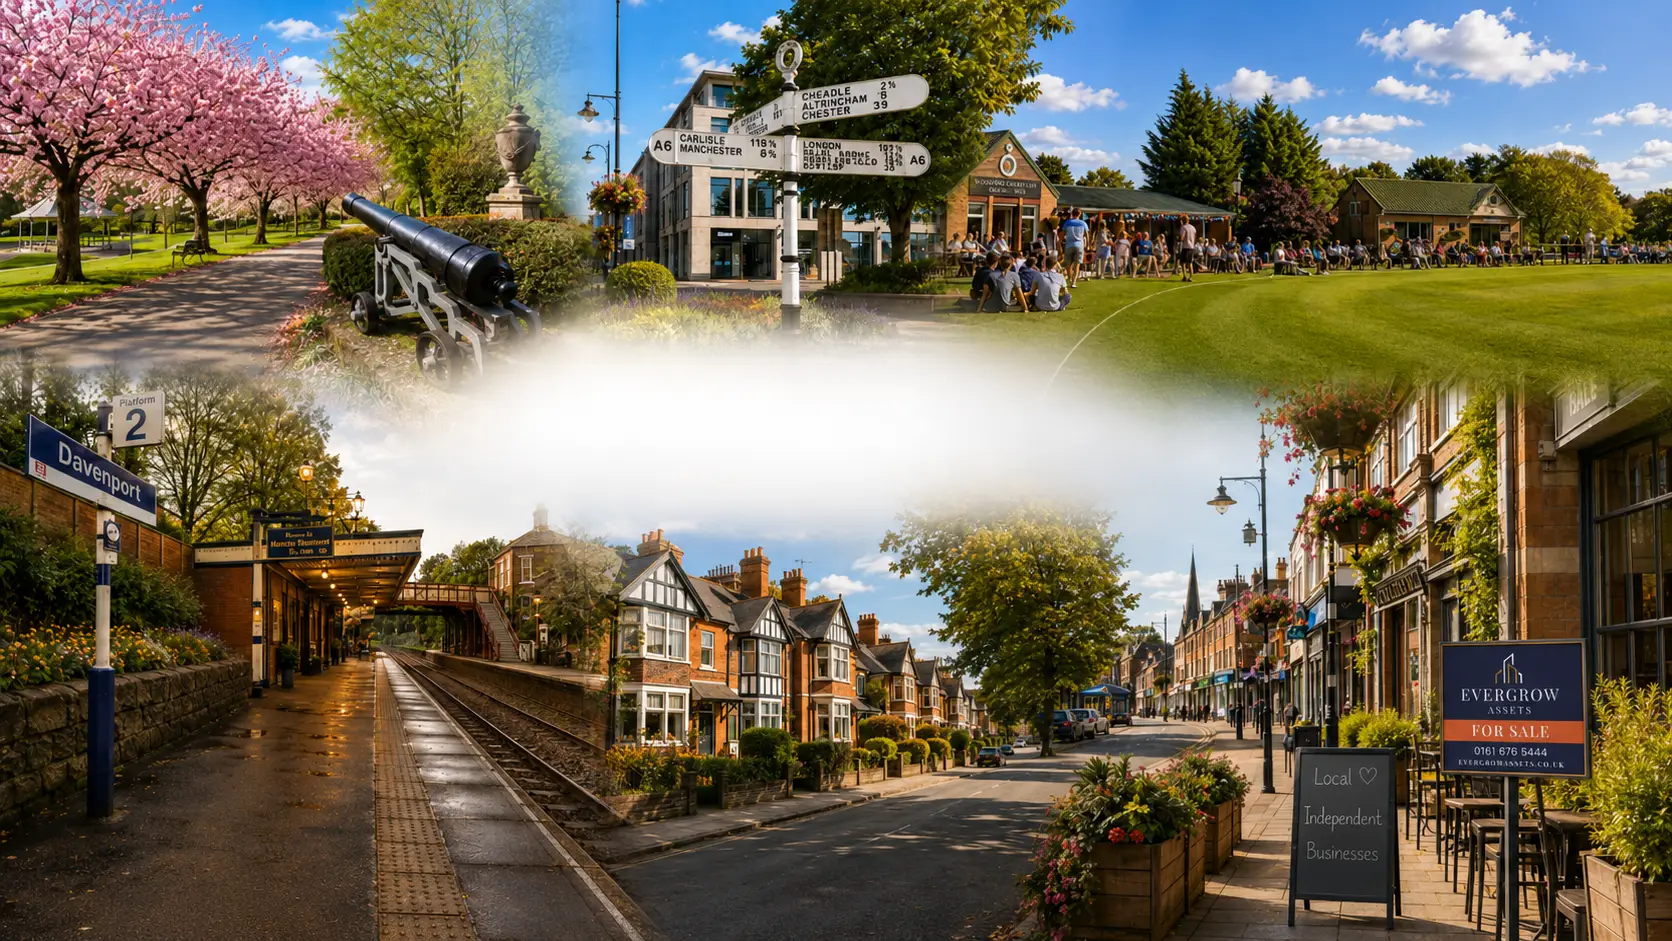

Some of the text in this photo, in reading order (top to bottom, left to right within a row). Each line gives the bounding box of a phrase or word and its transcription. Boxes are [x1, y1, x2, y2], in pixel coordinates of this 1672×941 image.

[802, 86, 851, 101] CHEADLE
[802, 94, 868, 111] ALTRINCHAM
[802, 100, 888, 120] CHESTER 39
[653, 140, 672, 152] A6
[680, 134, 726, 145] CARLISLE
[680, 144, 742, 156] MANCHESTER
[910, 156, 926, 165] A6
[119, 394, 156, 408] Platform
[125, 408, 147, 441] 2
[58, 441, 141, 502] Davenport
[1461, 688, 1560, 702] EVERGROW
[1487, 706, 1532, 715] ASSETS
[1471, 724, 1551, 738] FOR SALE
[1474, 746, 1547, 757] 0161 676 5444
[1314, 767, 1352, 786] Local
[1304, 805, 1383, 832] Independent
[1306, 840, 1379, 862] Businesses
